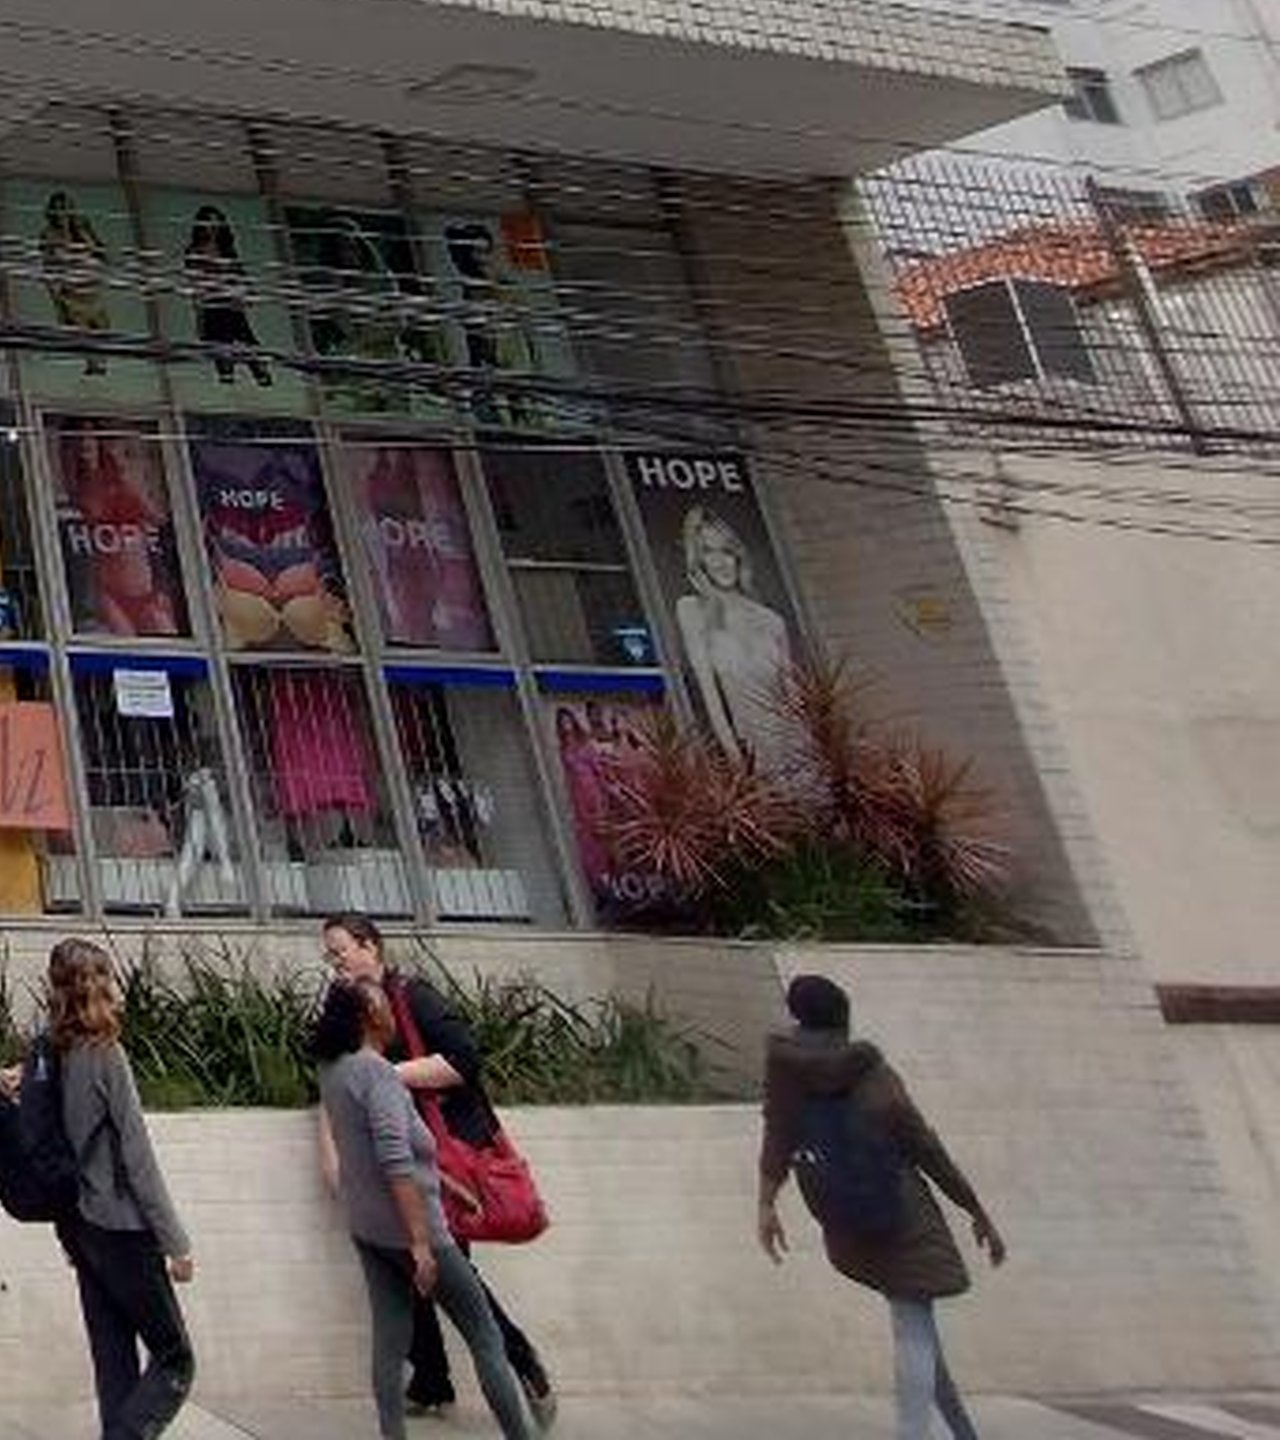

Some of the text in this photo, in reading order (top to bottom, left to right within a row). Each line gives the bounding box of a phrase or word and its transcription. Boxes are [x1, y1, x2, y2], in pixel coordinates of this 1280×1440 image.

[637, 456, 743, 492] HOPE
[220, 489, 285, 511] HOPE
[67, 523, 162, 556] HOPE
